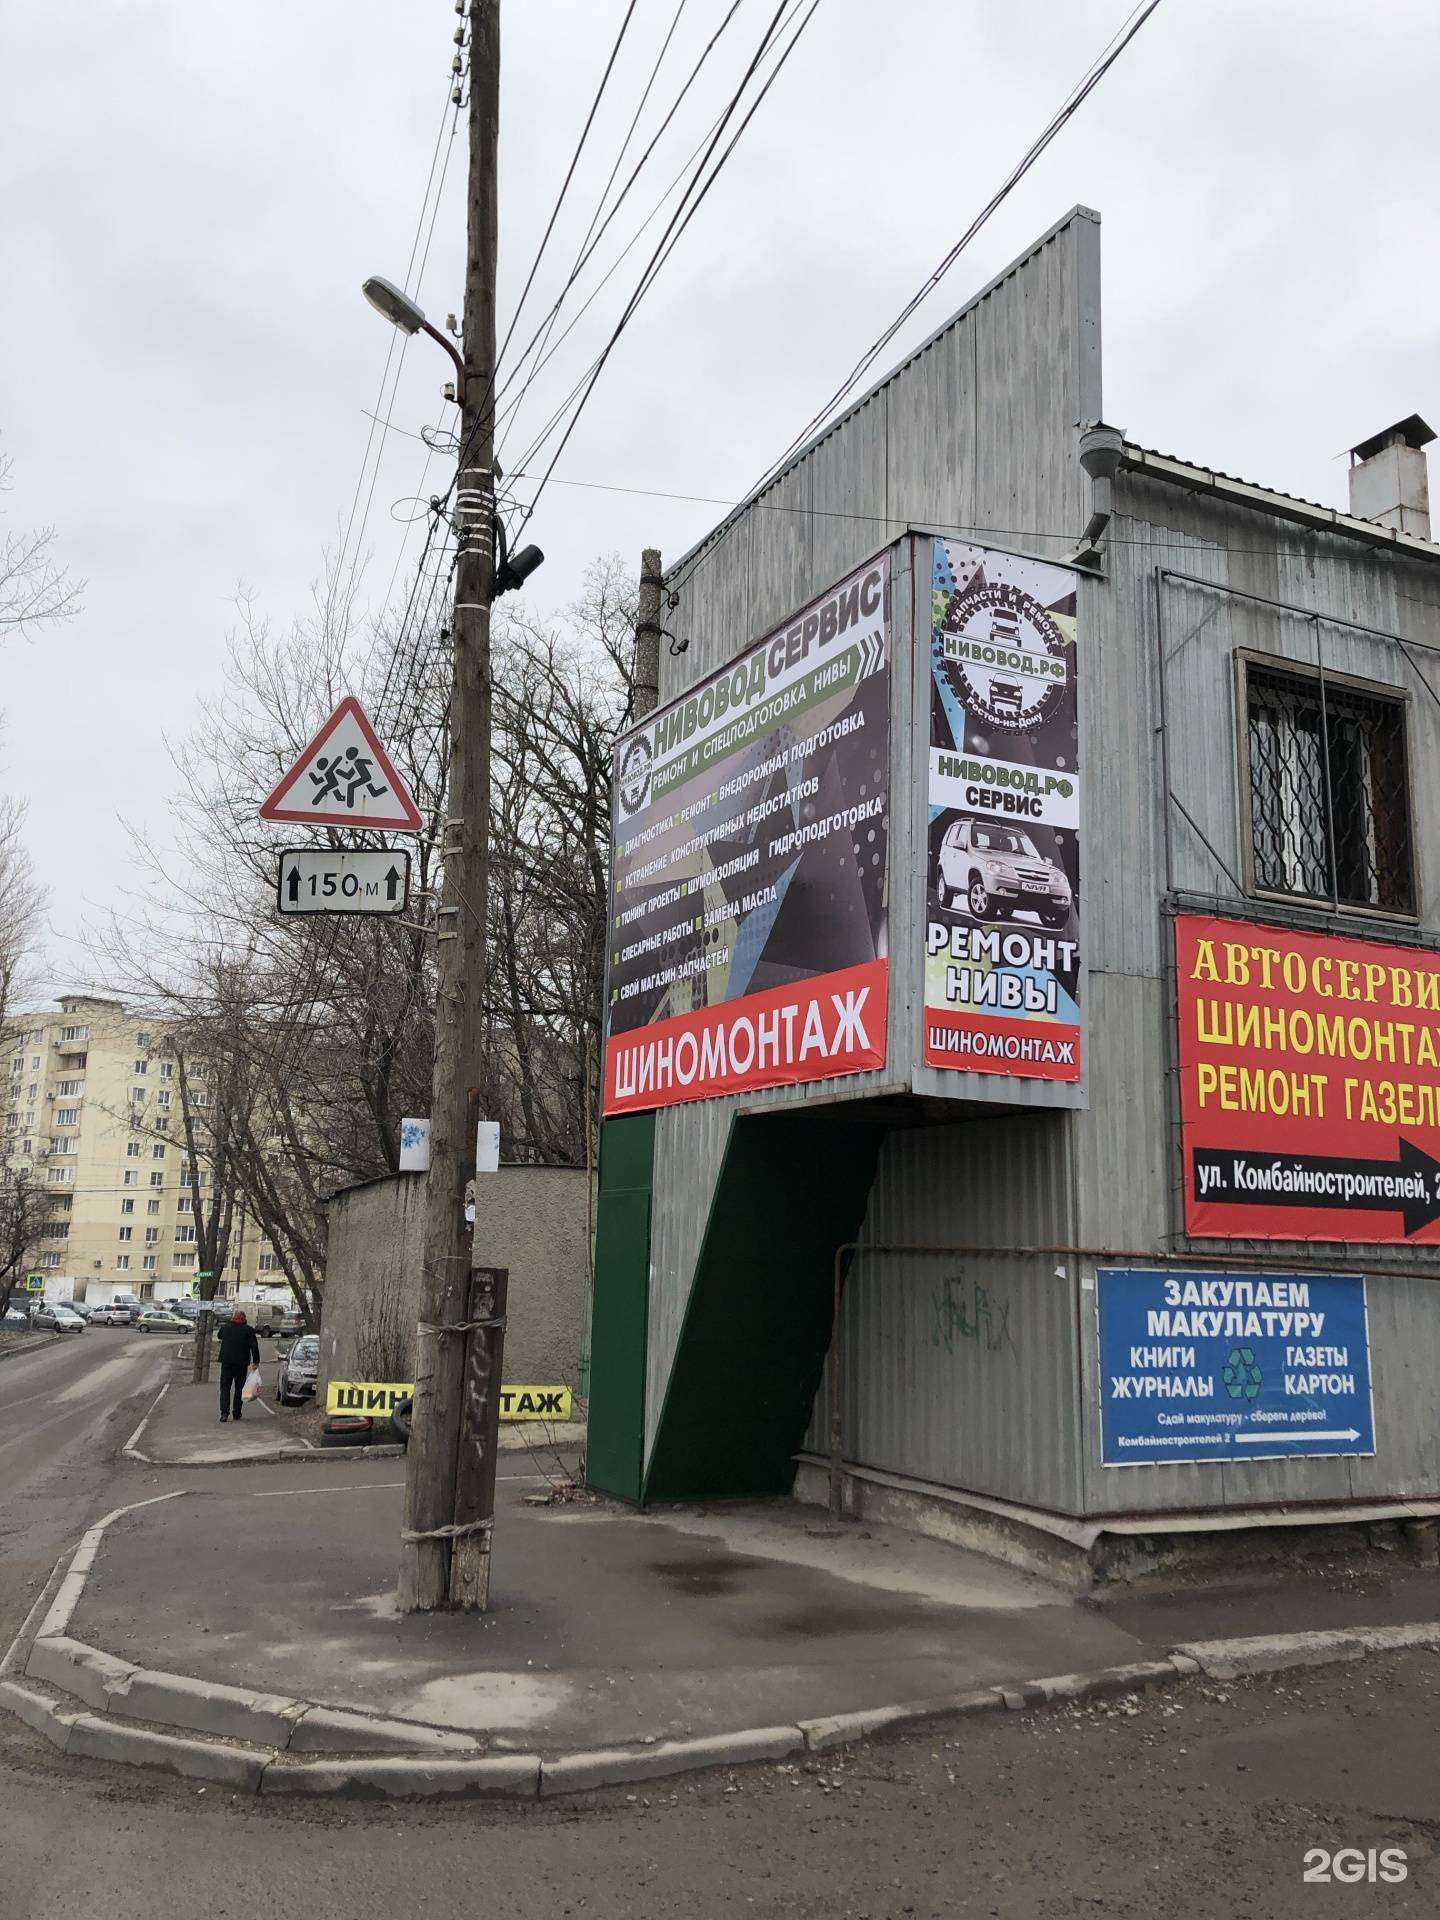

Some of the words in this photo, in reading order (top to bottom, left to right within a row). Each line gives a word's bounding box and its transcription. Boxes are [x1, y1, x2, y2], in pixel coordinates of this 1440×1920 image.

[951, 589, 1002, 624] ЗАПЧАСТИ
[1008, 592, 1018, 604] И
[1022, 600, 1060, 647] РЕМОНТ
[945, 637, 1066, 679] НИВОВОД.РФ
[652, 756, 688, 792] РЕМОНТ
[691, 748, 699, 768] И
[703, 683, 807, 760] СПЕЦПОДГОТОВКА
[813, 654, 851, 693] НИВЫ
[966, 696, 1044, 730] Ростов-на-Дону
[624, 815, 674, 857] ДИАГНОСТИКА
[680, 794, 712, 824] РЕМОНТ
[719, 749, 789, 800] ВНЕДОРОЖНАЯ
[791, 710, 866, 762] ПОДГОТОВКА
[938, 755, 1074, 799] НИВОВОД.РФ
[965, 785, 1044, 818] СЕРВИС
[624, 853, 668, 889] УСТРАНЕНИЕ
[670, 813, 745, 864] КОНСТРУКТИВНЫХ
[746, 776, 820, 826] НЕДОСТАТКОВ
[620, 902, 648, 927] ТЮНИНГ
[649, 884, 681, 913] ПРОЕКТЫ
[686, 848, 760, 895] ШУМОИЗОЛЯЦИЯ
[768, 795, 883, 859] ГИДРОПОДГОТОВКА
[307, 873, 359, 897] 150
[621, 932, 662, 963] СЛЕСАРНЫЕ
[662, 918, 694, 947] РАБОТЫ
[703, 900, 741, 928] ЗАМЕНА
[742, 884, 778, 913] МАСЛА
[928, 921, 1077, 973] РЕМОНТ
[620, 977, 640, 1000] СВОЙ
[640, 966, 677, 994] МАГАЗИН
[677, 945, 730, 981] ЗАПЧАСТЕЙ
[946, 965, 1057, 1014] НИВЫ
[614, 985, 871, 1100] ШИНОМОНТАЖ
[929, 1026, 1075, 1065] ШИНОМОНТАЖ
[1196, 998, 1440, 1068] ШИНОМОНТА
[1198, 1062, 1329, 1118] РЕМОНТ
[1344, 1077, 1440, 1127] ГАЗЕЛ
[1198, 1162, 1227, 1194] ул.
[1233, 1159, 1430, 1205] Комбайностроителей,
[1164, 1279, 1310, 1308] ЗАКУПАЕМ
[1147, 1310, 1325, 1338] МАКУЛАТУРУ
[1130, 1346, 1195, 1369] КНИГИ
[1286, 1346, 1348, 1368] ГАЗЕТЫ
[1111, 1375, 1214, 1399] ЖУРНАЛЫ
[1284, 1374, 1355, 1395] КАРТОН
[1157, 1412, 1184, 1426] Сдай
